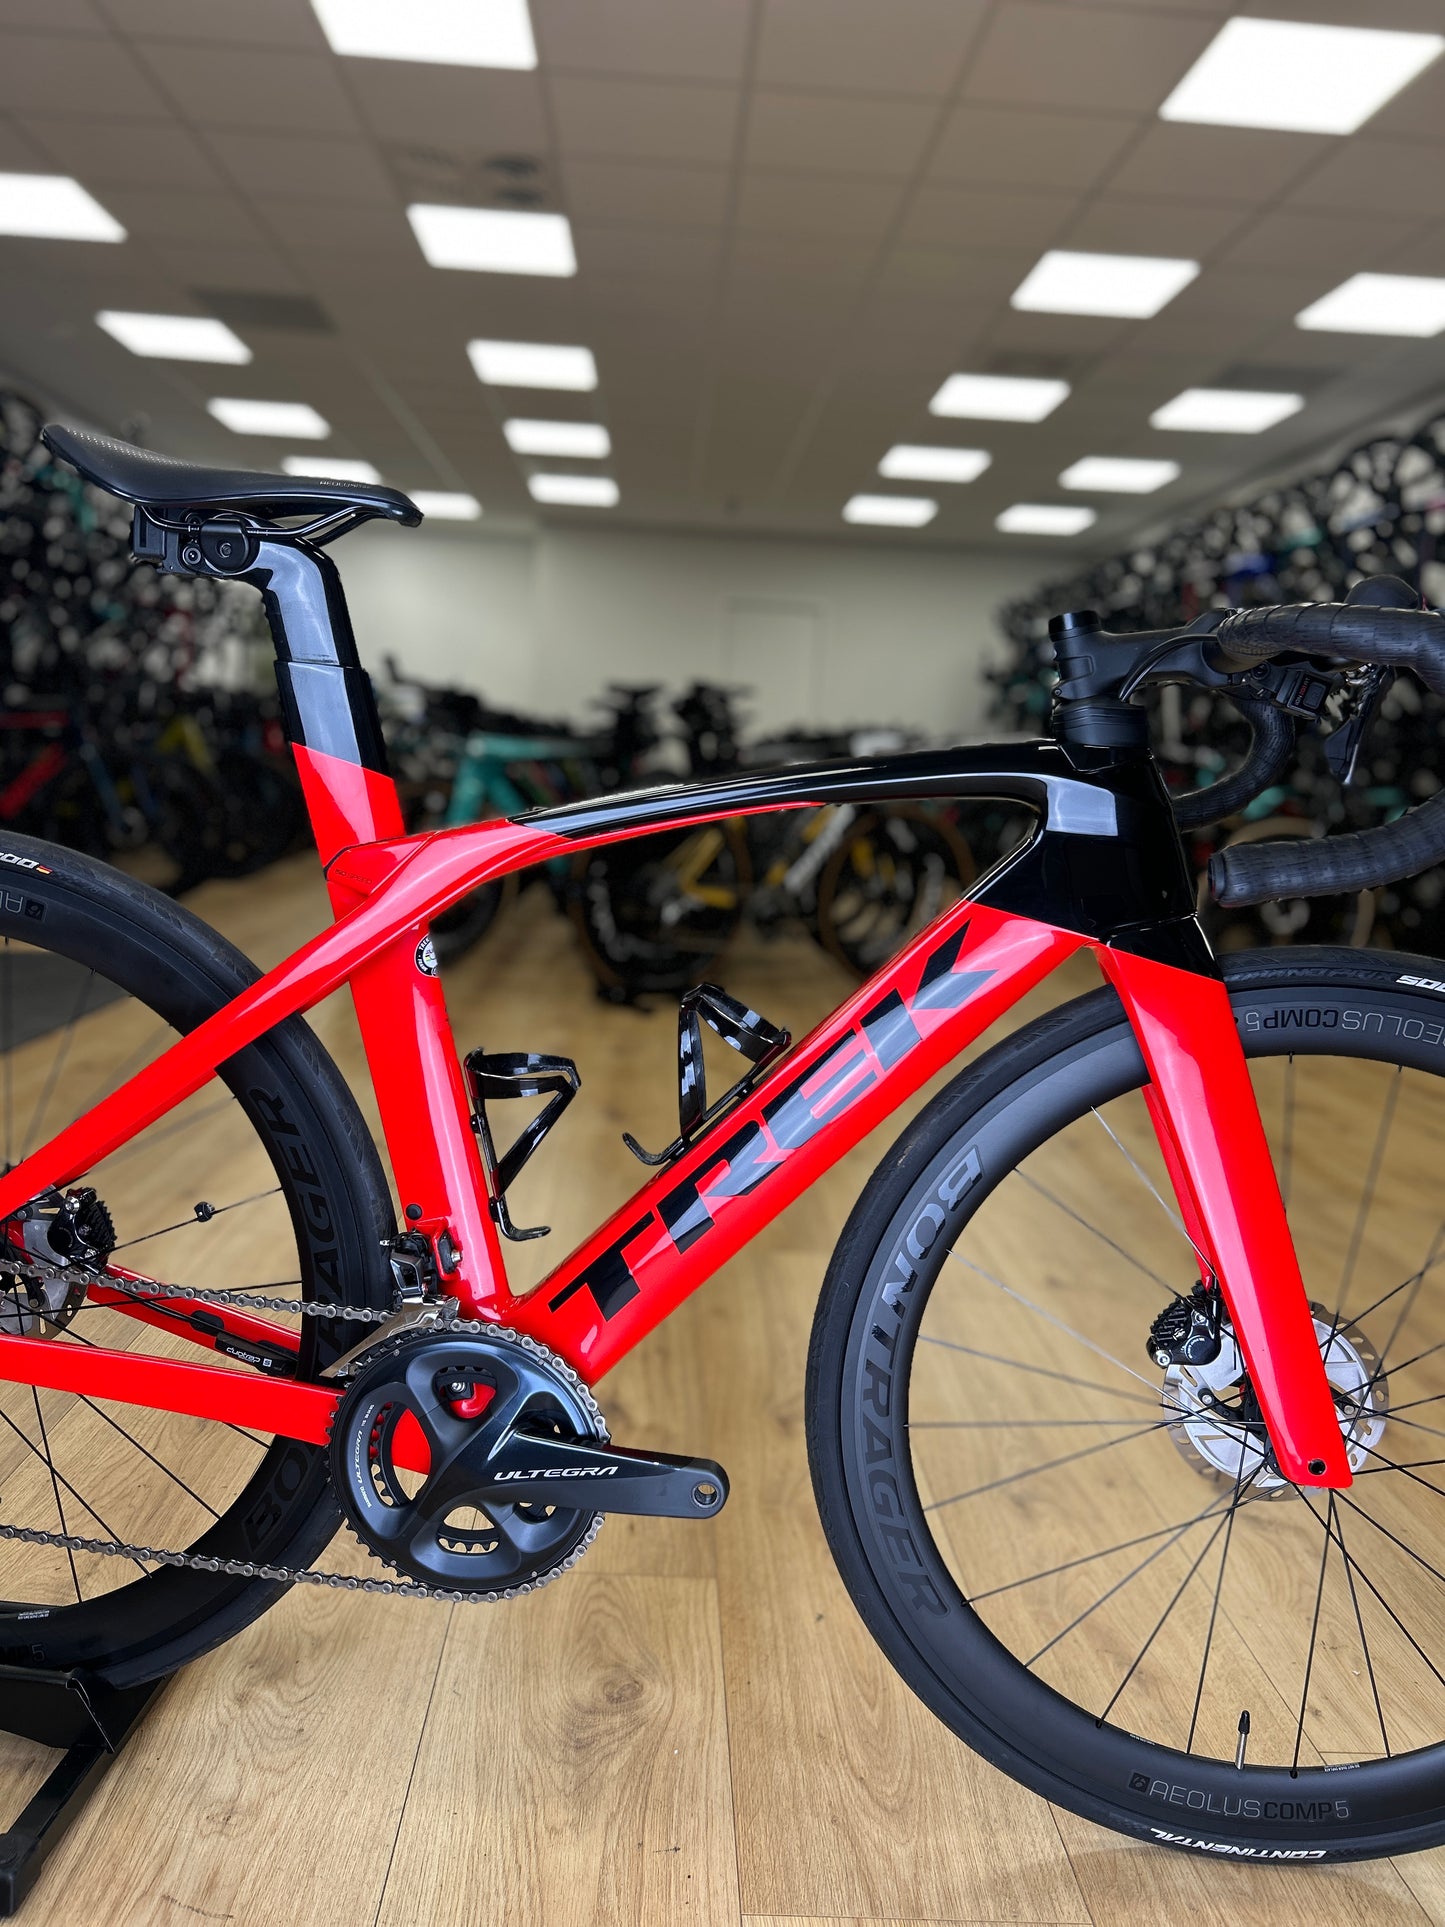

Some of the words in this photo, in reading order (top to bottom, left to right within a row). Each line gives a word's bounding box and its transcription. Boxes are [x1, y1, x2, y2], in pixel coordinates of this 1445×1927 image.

[0, 852, 40, 869] 00
[1245, 1011, 1261, 1032] 5
[1263, 1009, 1339, 1029] COMP
[1341, 1010, 1445, 1046] EOLUS
[548, 918, 998, 1322] TREK
[862, 1145, 983, 1615] BONTRAGER
[354, 1430, 363, 1484] ULTEGRA
[494, 1466, 618, 1480] ULTEGRA
[1149, 1780, 1261, 1818] AEOLUS
[1263, 1801, 1333, 1821] COMP
[1335, 1800, 1350, 1819] 5
[1150, 1827, 1327, 1860] CONTINENTAL
